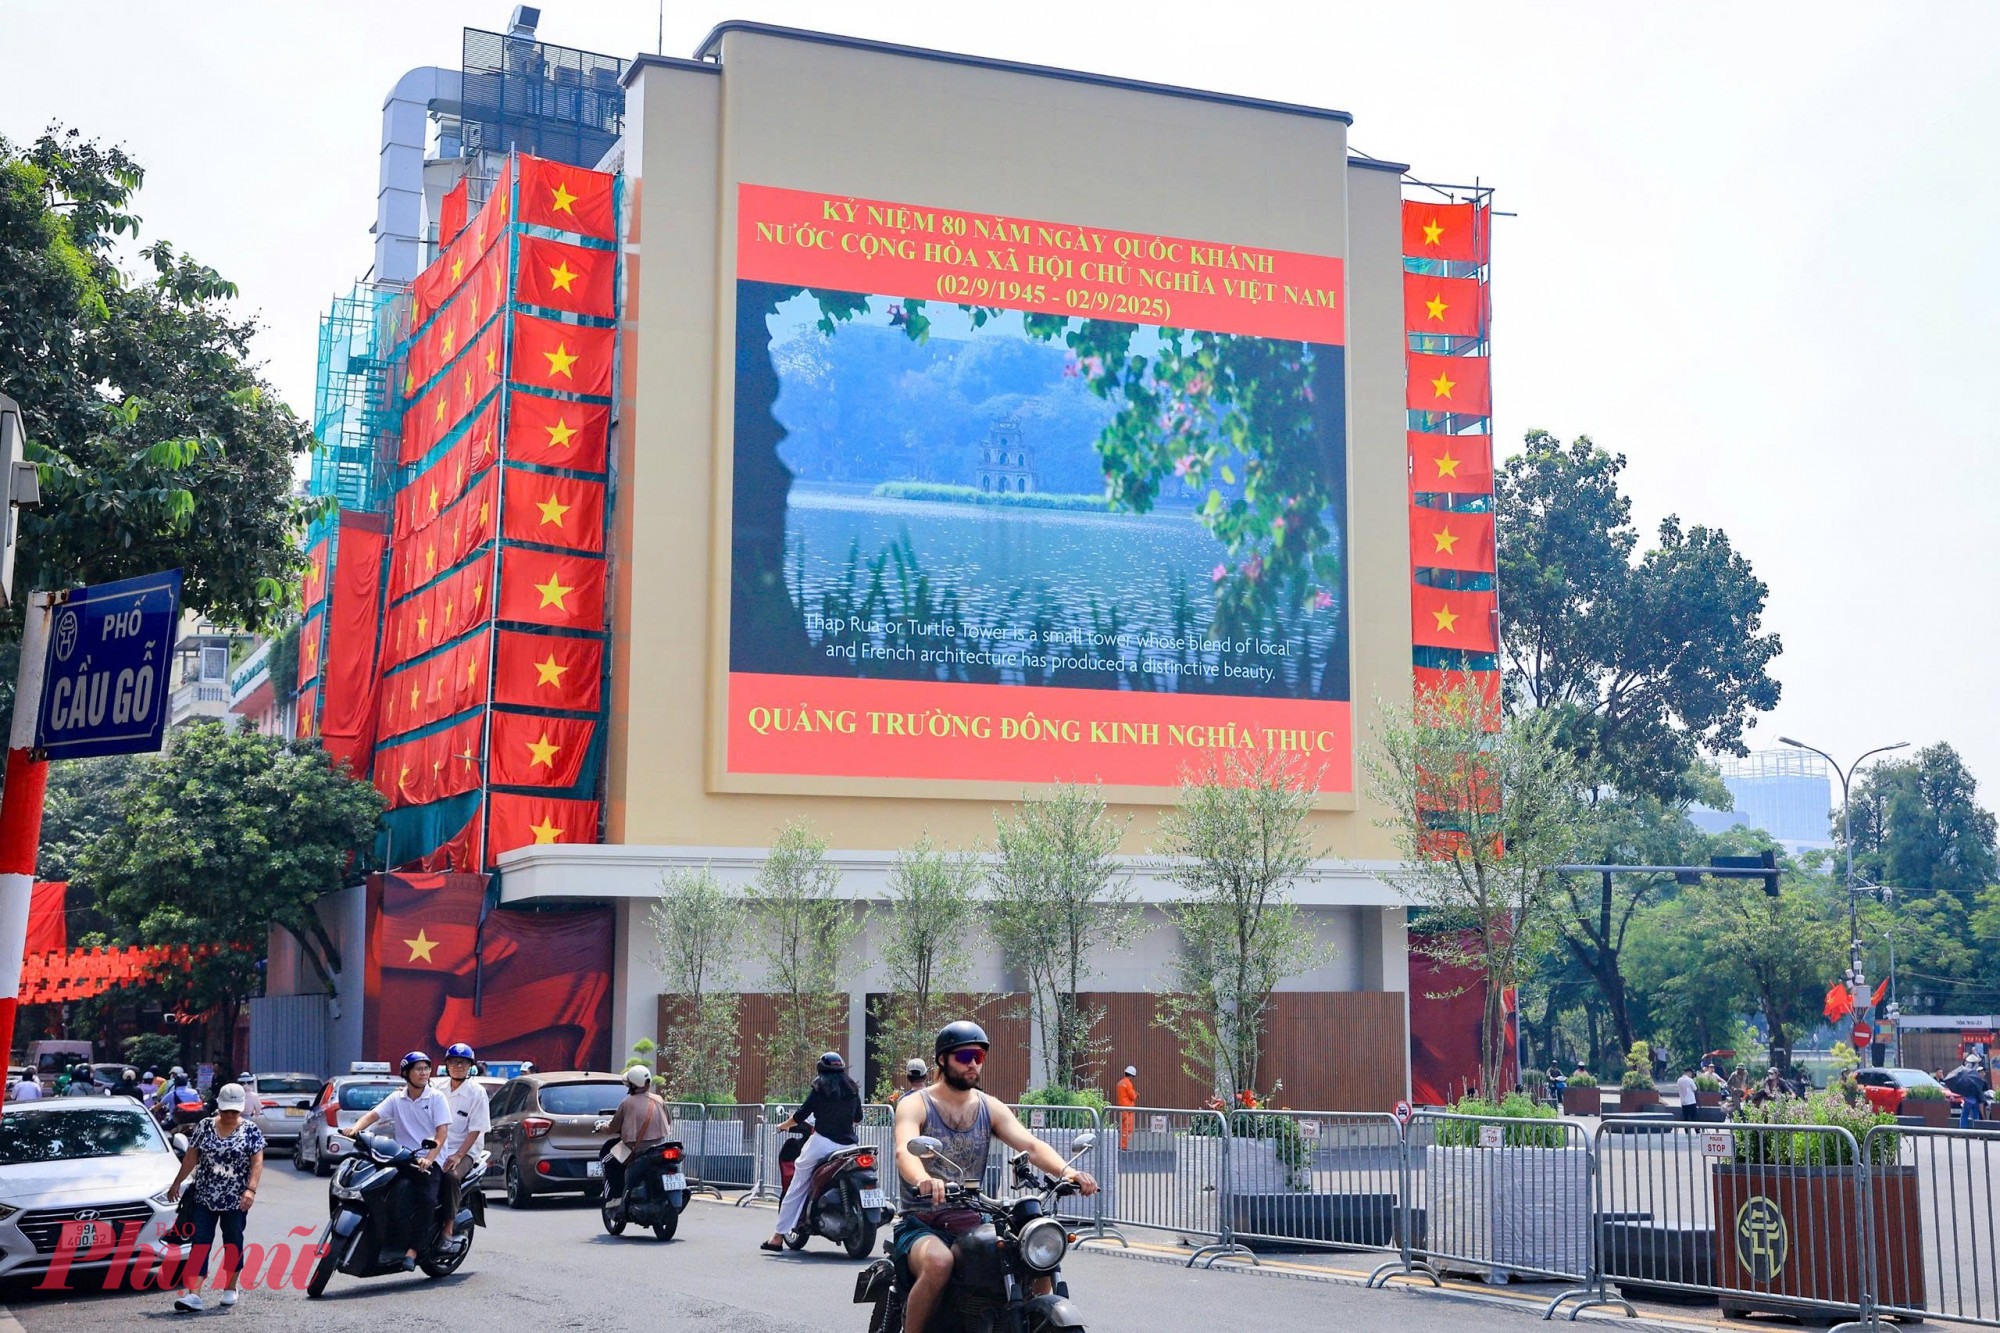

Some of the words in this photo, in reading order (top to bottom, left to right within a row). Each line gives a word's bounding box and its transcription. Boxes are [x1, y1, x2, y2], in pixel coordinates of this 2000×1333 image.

[822, 198, 861, 222] KỶ
[867, 205, 935, 234] NIỆM
[942, 215, 967, 236] 80
[974, 217, 1031, 244] NĂM
[1038, 227, 1108, 253] NGÀY
[1114, 236, 1184, 263] QUỐC
[1190, 245, 1274, 274] KHÁNH
[756, 222, 834, 250] NƯỚC
[841, 232, 916, 260] CỘNG
[924, 240, 979, 268] HÒA
[986, 248, 1020, 272] XÃ
[1028, 255, 1073, 282] HỘI
[1080, 260, 1132, 285] CHỦ
[1138, 268, 1216, 295] NGHĨA
[1222, 278, 1278, 305] VIỆT
[1283, 285, 1337, 309] NAM
[936, 274, 1046, 304] (02/9/1945
[1066, 288, 1172, 322] 02/9/2025)
[101, 595, 146, 641] PHỐ
[803, 613, 845, 638] Thap
[850, 616, 880, 634] Rua
[885, 621, 902, 635] or
[907, 619, 955, 638] Turtle
[960, 622, 1008, 641] Tower
[1013, 625, 1025, 641] is
[1029, 629, 1038, 642] a
[1042, 627, 1082, 646] small
[1088, 632, 1131, 648] tower
[1137, 633, 1185, 650] whose
[1189, 635, 1231, 653] blend
[1235, 637, 1250, 655] of
[1256, 638, 1290, 656] local
[51, 654, 110, 731] CẦU
[112, 640, 156, 725] GỖ
[826, 641, 856, 658] and
[862, 642, 915, 661] French
[921, 646, 1016, 667] architecture
[1021, 651, 1047, 669] has
[1052, 653, 1125, 674] produced
[1130, 659, 1138, 673] a
[1142, 657, 1219, 677] distinctive
[1224, 661, 1276, 684] beauty.
[749, 702, 856, 736] QUẢNG
[866, 708, 992, 739] TRƯỜNG
[1000, 711, 1081, 742] ĐÔNG
[1090, 721, 1159, 745] KINH
[1168, 722, 1255, 749] NGHĨA
[1262, 728, 1335, 757] THỤC
[1707, 1143, 1726, 1152] STOP
